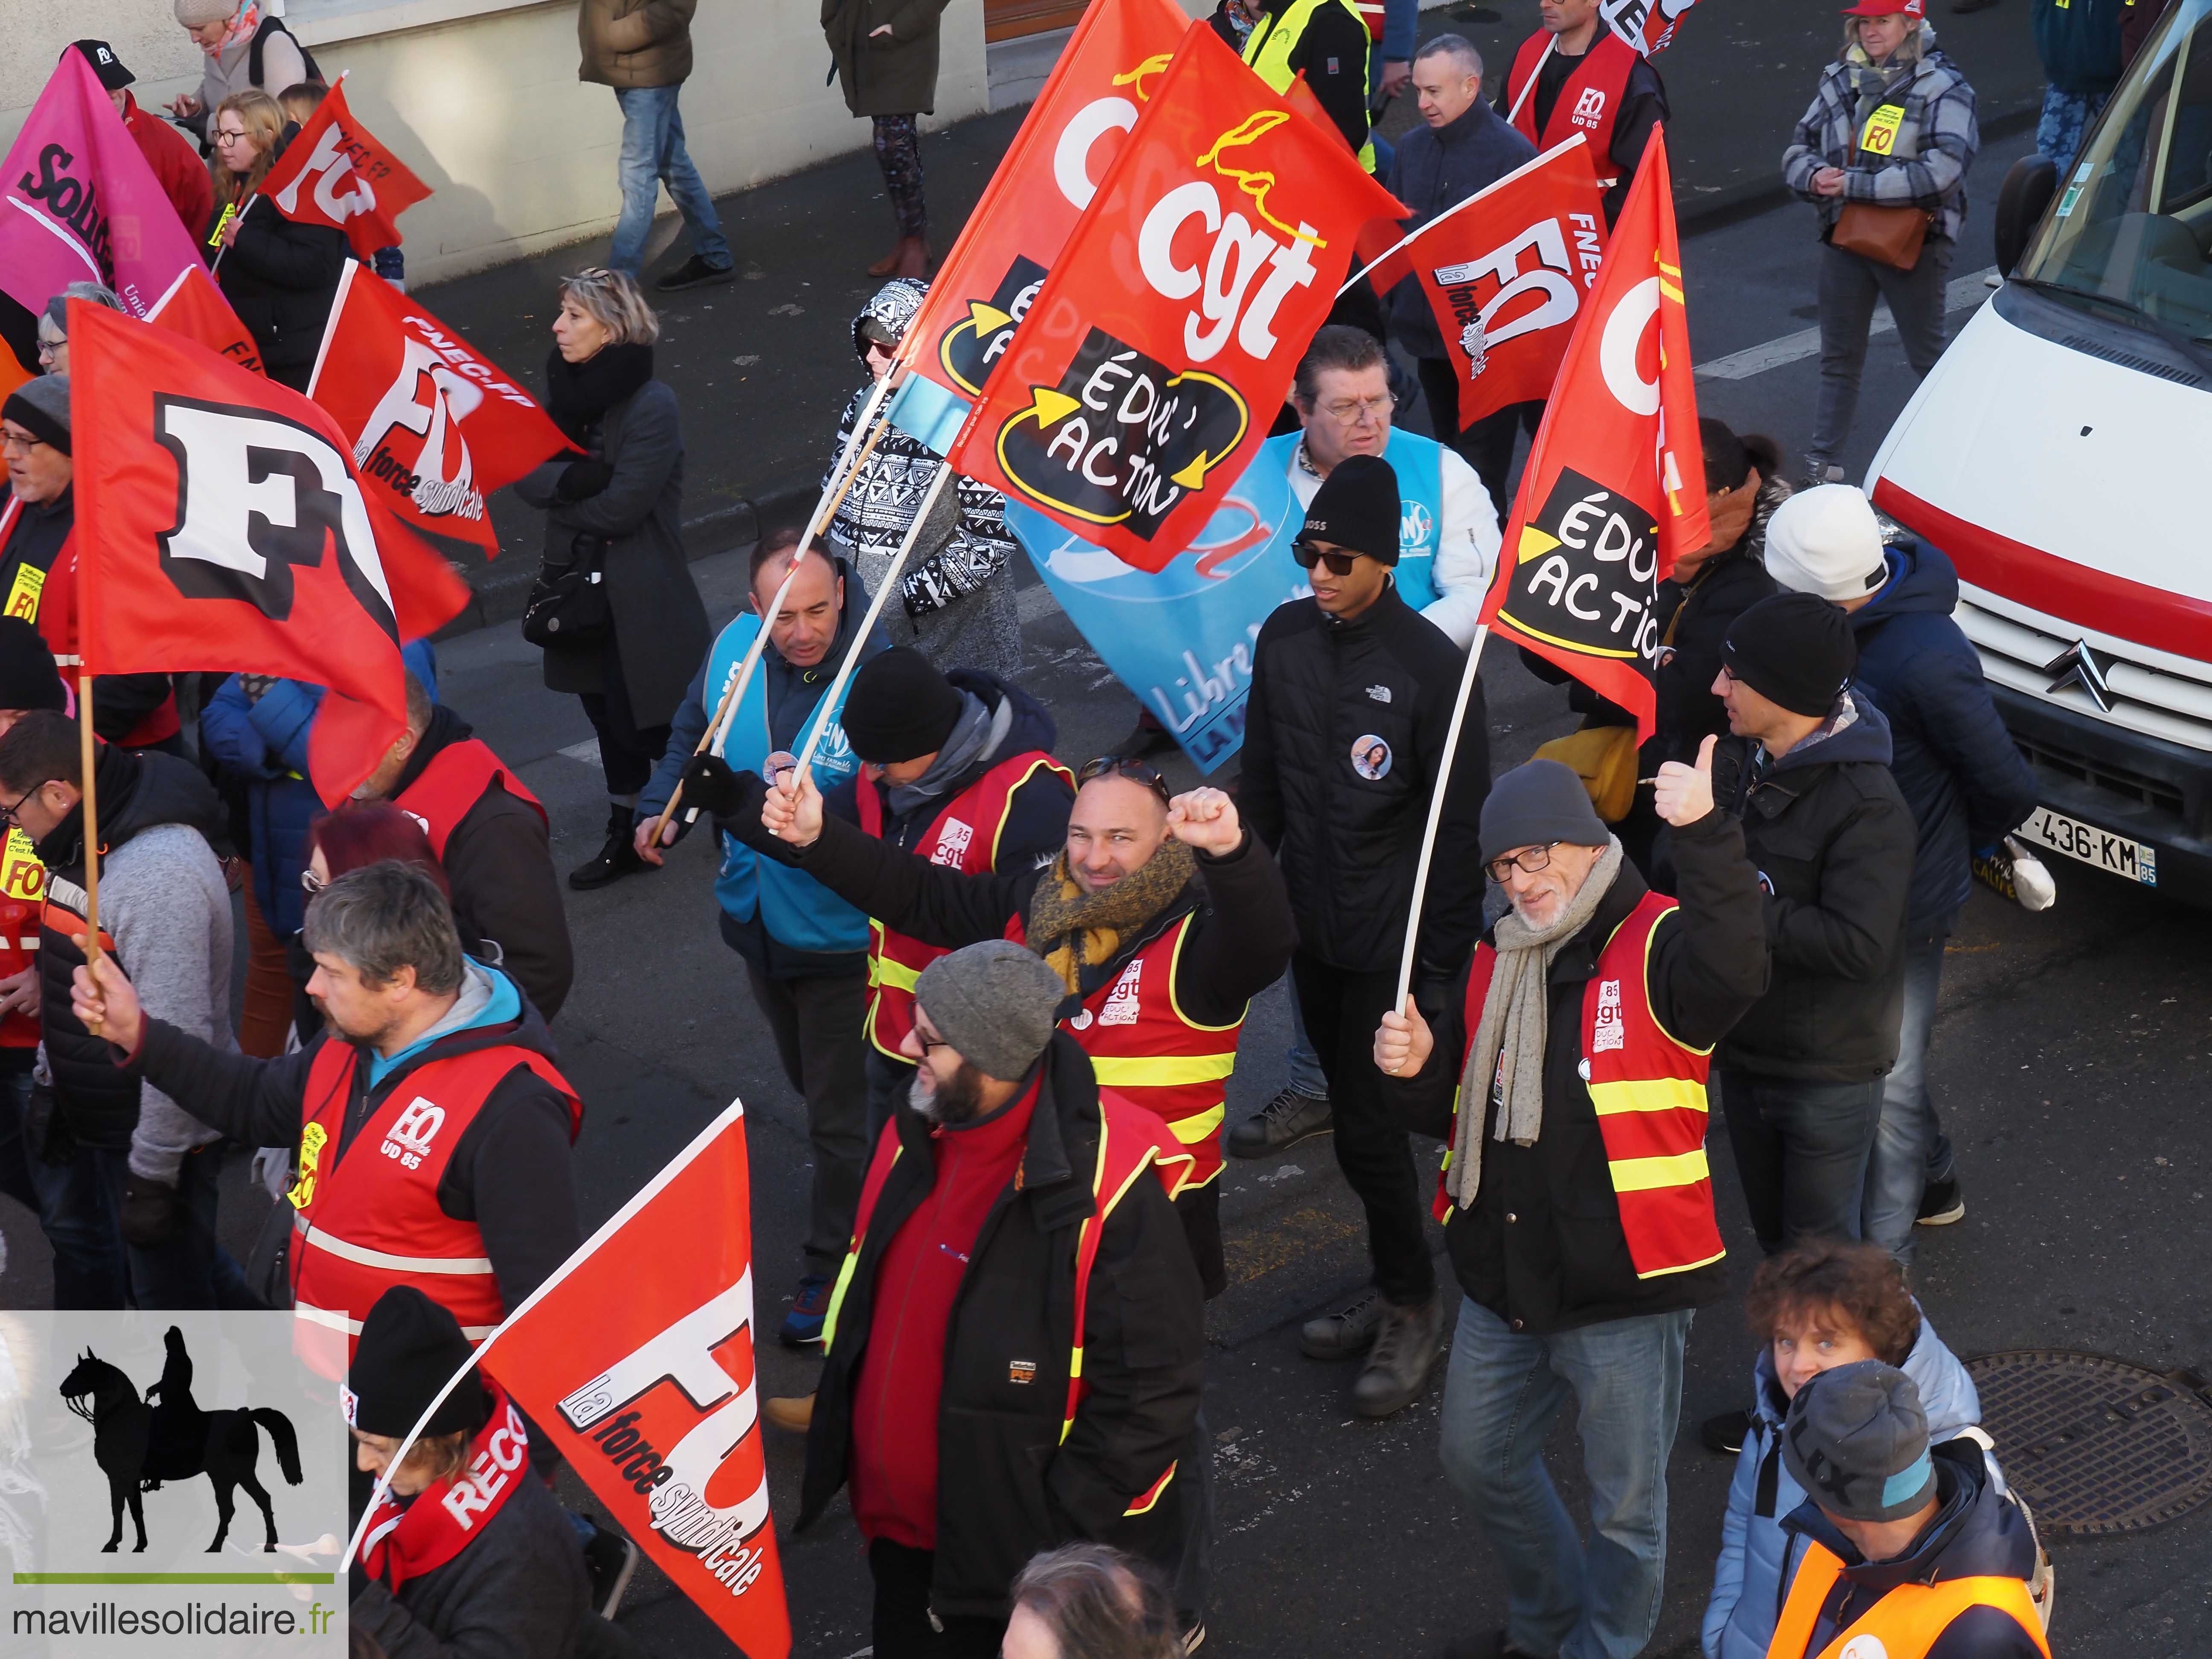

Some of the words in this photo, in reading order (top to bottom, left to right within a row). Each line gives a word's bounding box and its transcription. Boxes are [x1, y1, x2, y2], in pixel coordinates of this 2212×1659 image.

[1573, 87, 1605, 116] FO
[1572, 115, 1585, 125] UD
[1586, 119, 1598, 129] 85
[1866, 125, 1892, 151] FO
[1138, 181, 1318, 362] cgt
[1433, 218, 1579, 355] FO
[1437, 264, 1469, 283] la
[1446, 285, 1481, 327] force
[351, 335, 483, 512] FO
[367, 447, 421, 497] force
[413, 480, 483, 522] syndicale
[9, 591, 35, 621] FO
[1151, 641, 1254, 734] Libre
[935, 843, 965, 866] cgt
[2017, 814, 2136, 876] -436-KM
[6, 859, 45, 896] FO
[2141, 865, 2156, 883] 85
[1127, 963, 1140, 973] 85
[1606, 984, 1618, 997] 85
[386, 1096, 446, 1150] FO
[380, 1140, 401, 1159] UD
[400, 1152, 422, 1170] 85
[563, 1373, 612, 1424] la
[593, 1411, 674, 1495] force
[649, 1482, 764, 1597] syndicale
